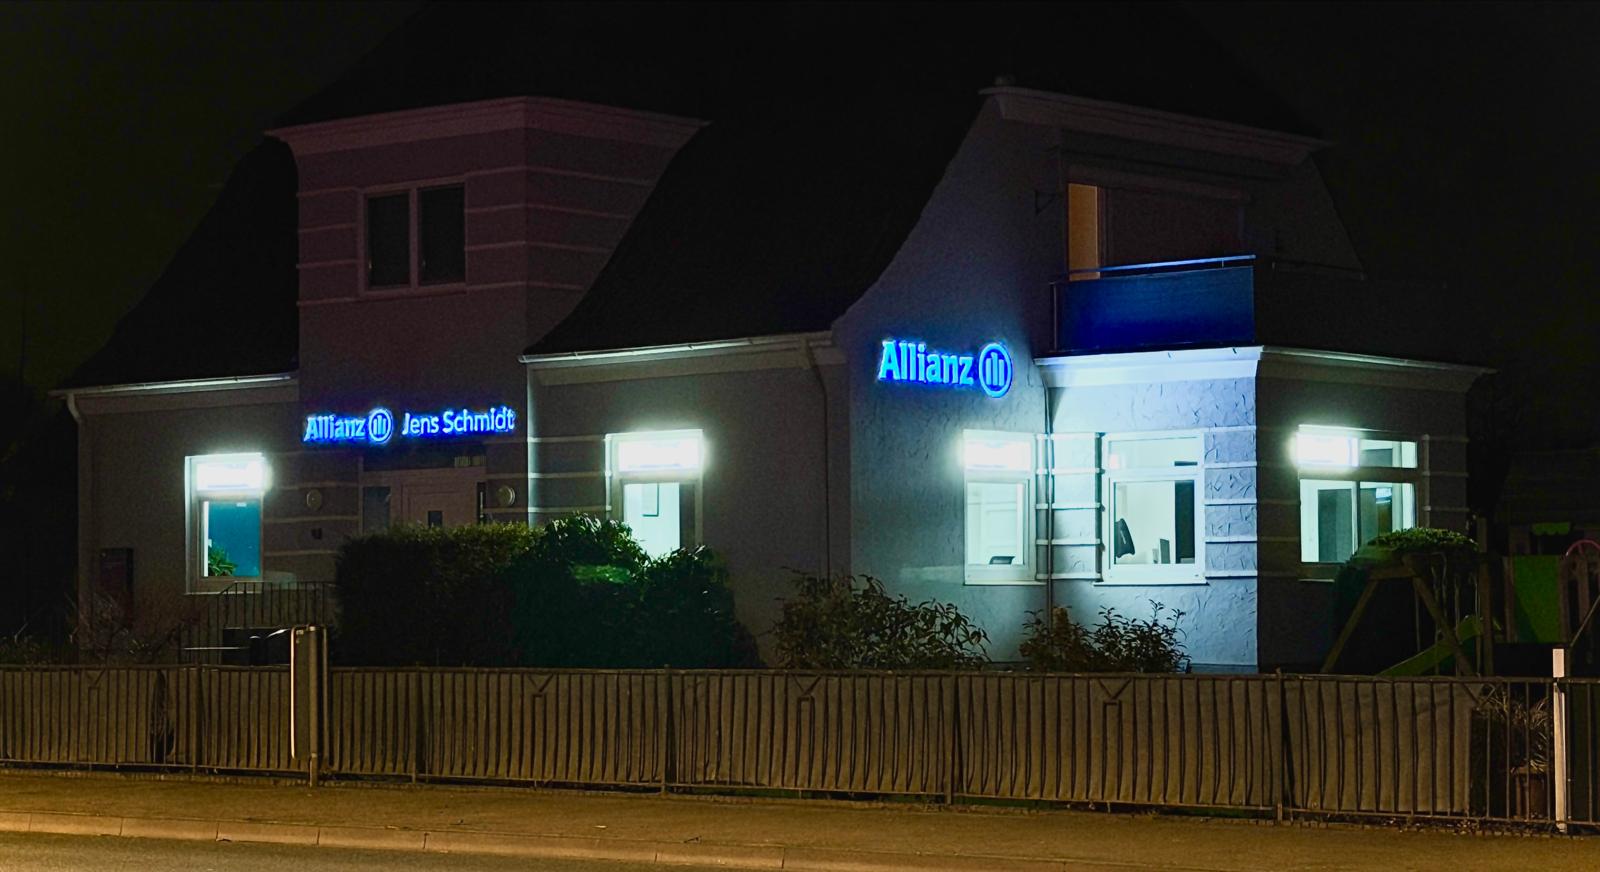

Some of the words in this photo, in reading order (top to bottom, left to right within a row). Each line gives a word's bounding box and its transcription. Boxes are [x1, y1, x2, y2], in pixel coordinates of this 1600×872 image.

[879, 340, 974, 385] Allianz
[303, 414, 366, 441] Allianz
[401, 412, 440, 435] Jens
[442, 405, 515, 434] Schmidt
